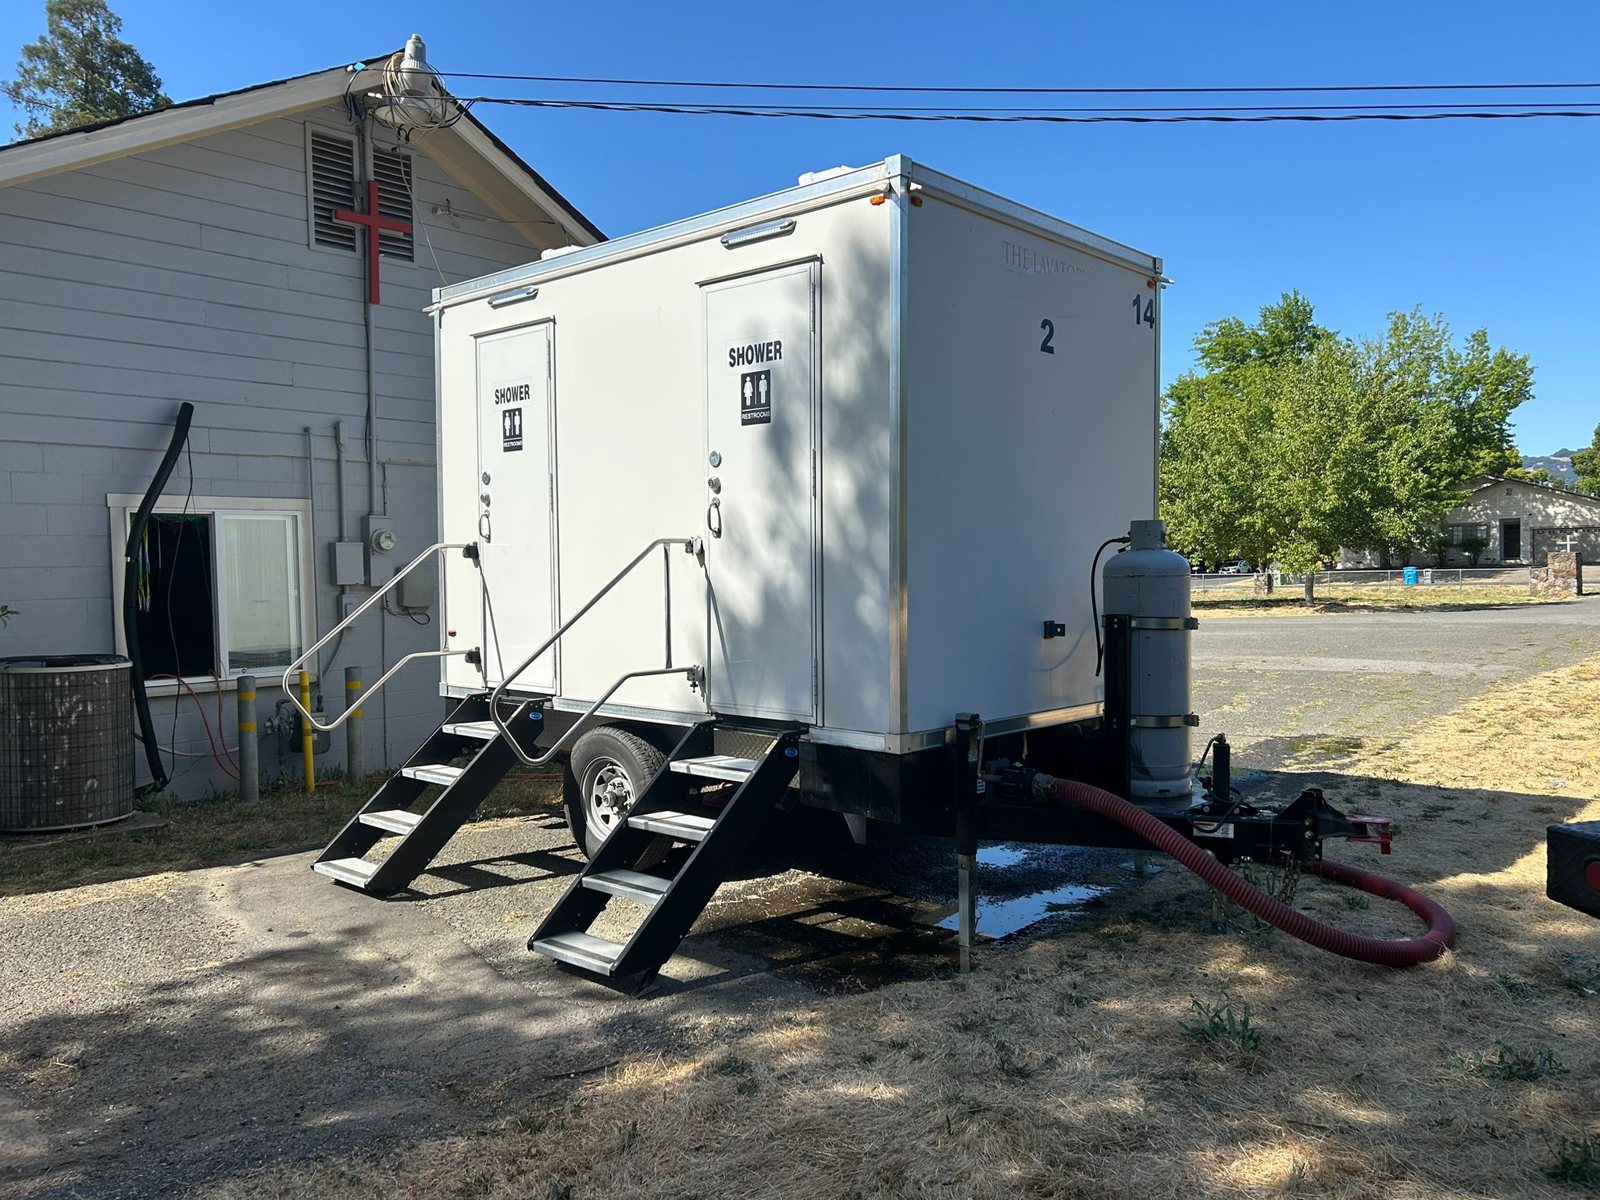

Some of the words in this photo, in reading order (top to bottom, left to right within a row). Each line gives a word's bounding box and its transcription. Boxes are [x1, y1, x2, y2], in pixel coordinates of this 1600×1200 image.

[1002, 240, 1029, 270] THE
[1132, 294, 1155, 329] 14
[1040, 318, 1055, 355] 2
[729, 340, 782, 368] SHOWER
[494, 383, 530, 405] SHOWER
[741, 411, 770, 420] RESTROOMS
